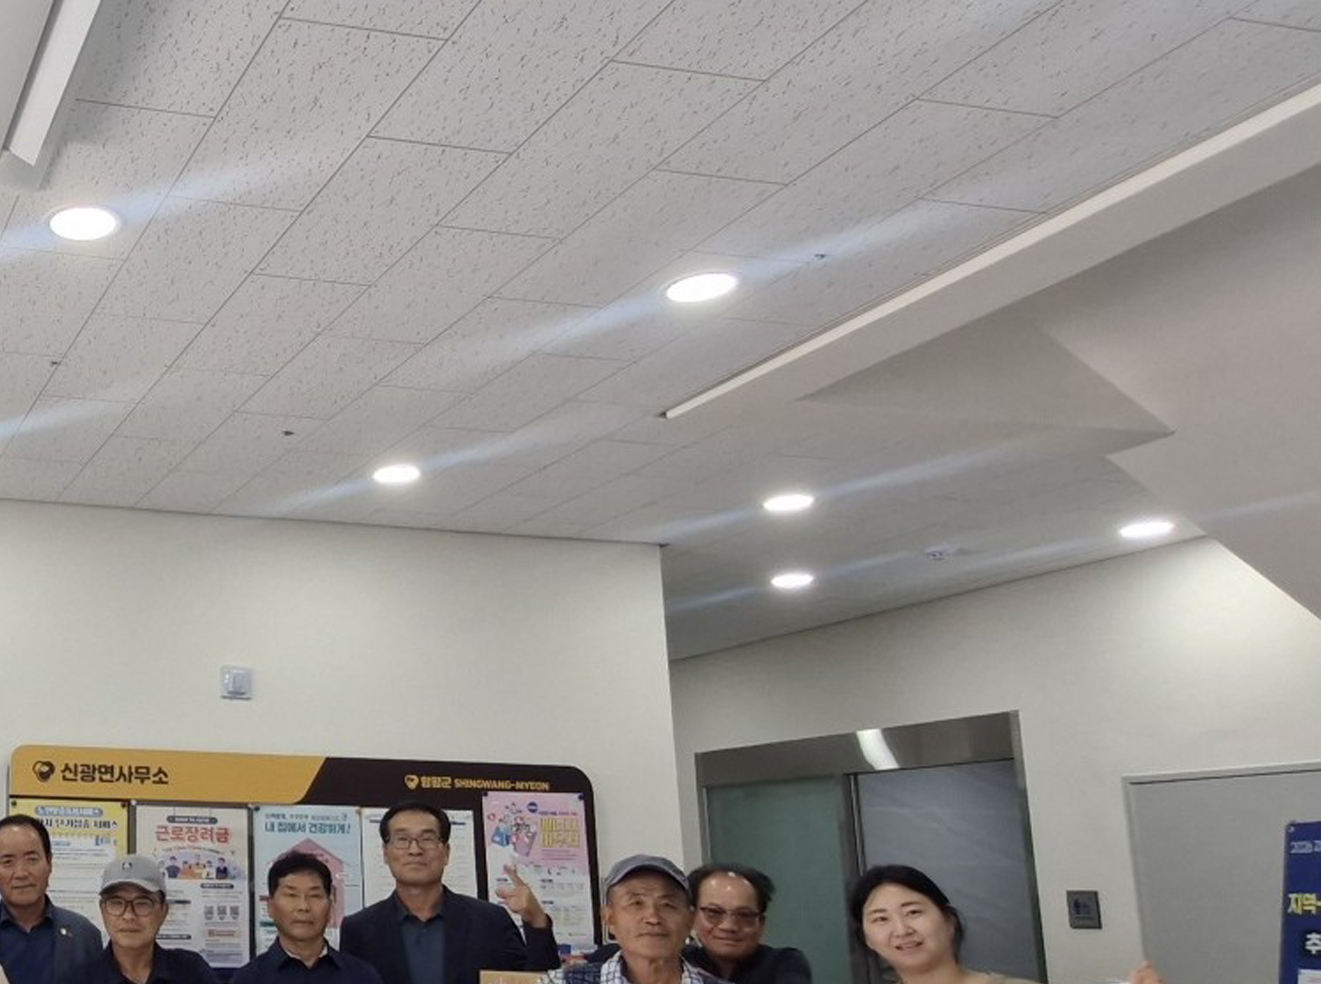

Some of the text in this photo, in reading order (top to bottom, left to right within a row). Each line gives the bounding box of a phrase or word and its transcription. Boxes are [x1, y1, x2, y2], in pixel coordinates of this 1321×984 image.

[60, 763, 169, 786] 신광면사무소
[454, 779, 550, 790] SHINGWANG-MYEON
[155, 825, 231, 844] 근로장려금
[1287, 893, 1321, 915] 지역
